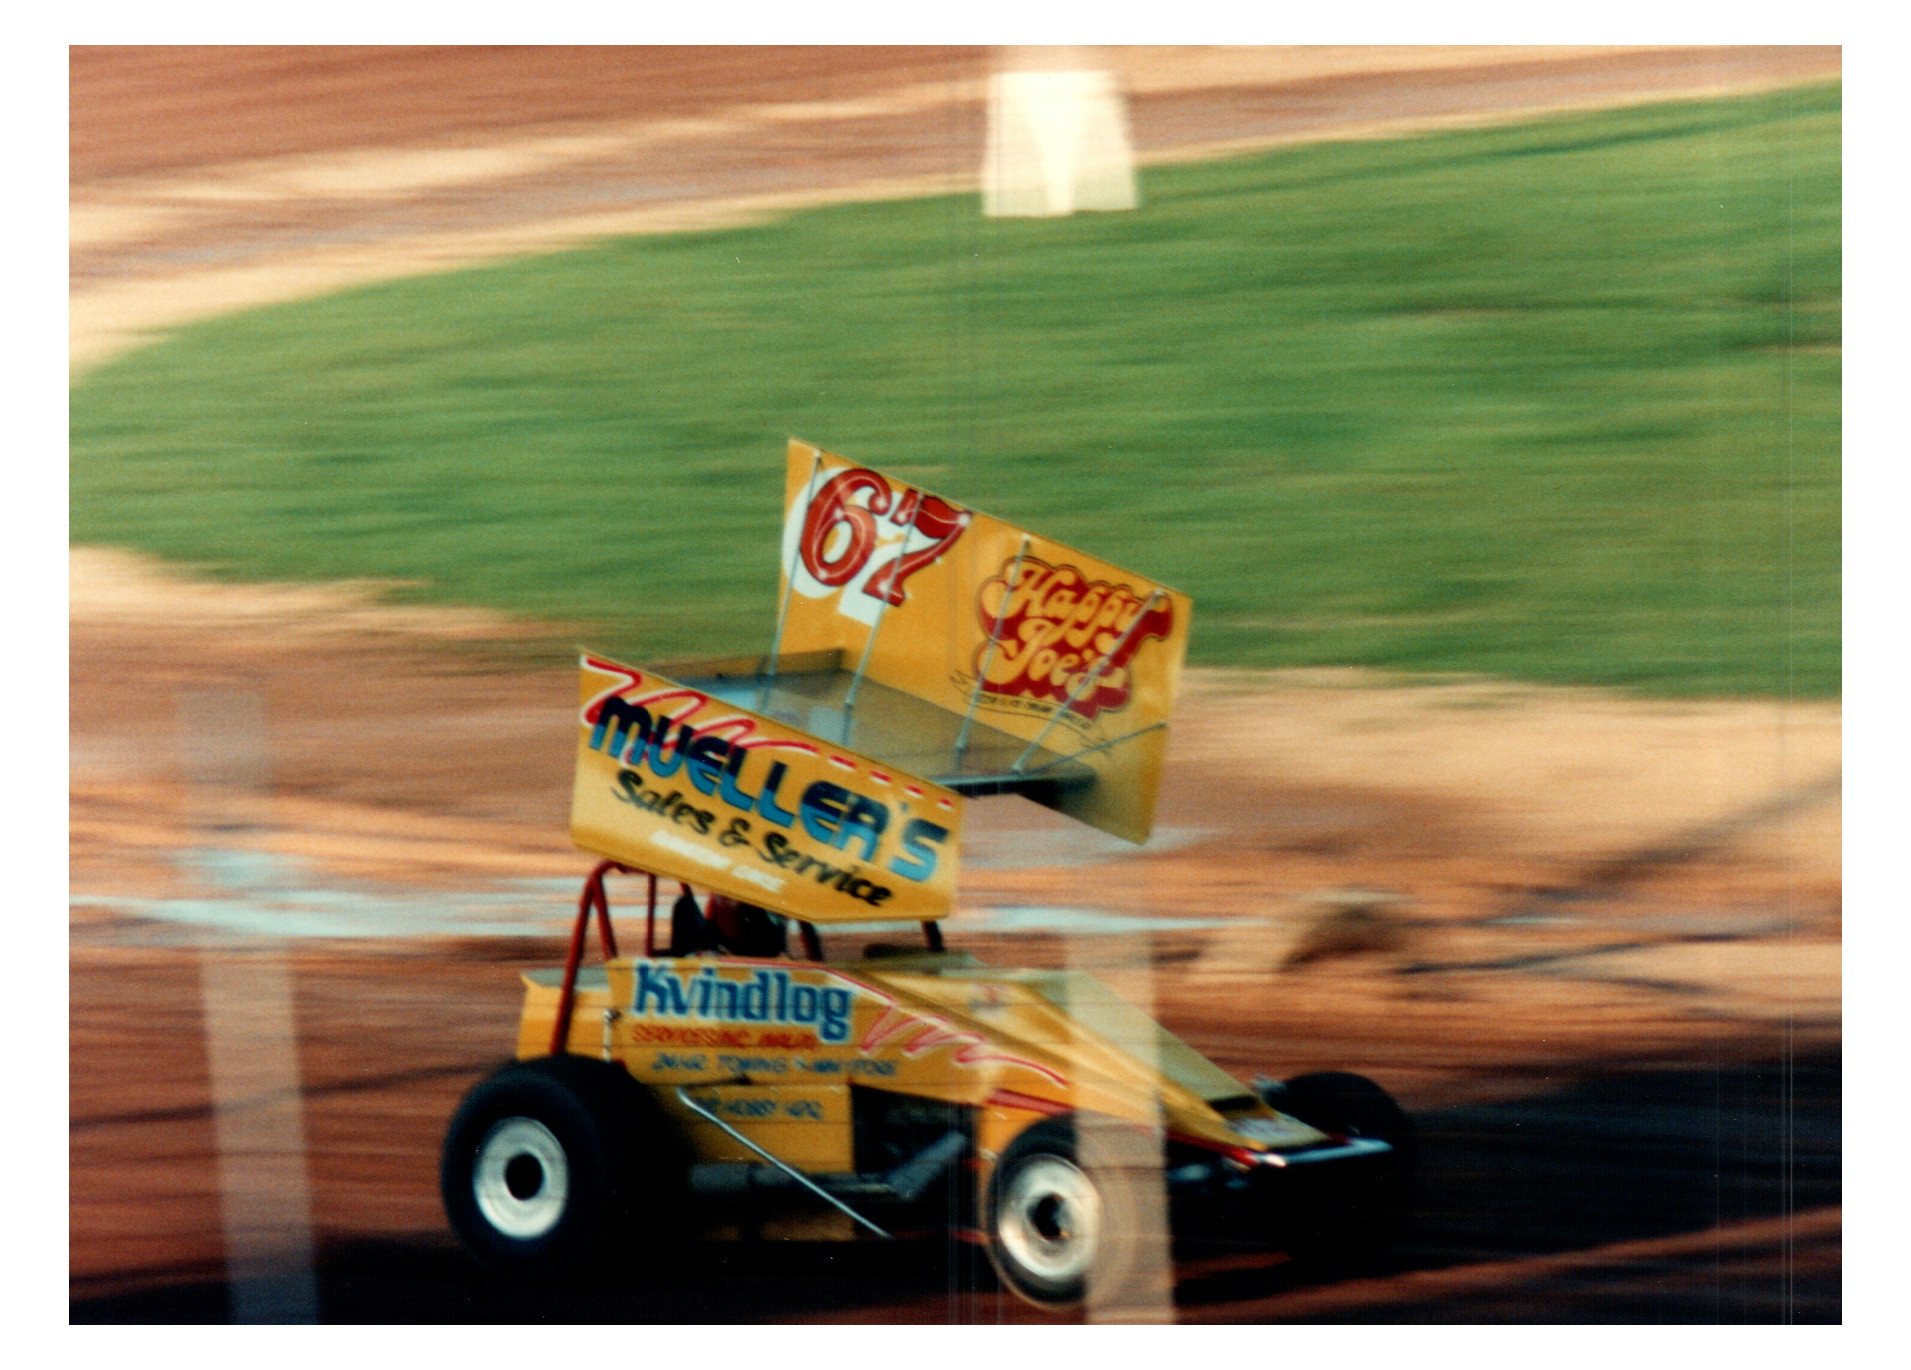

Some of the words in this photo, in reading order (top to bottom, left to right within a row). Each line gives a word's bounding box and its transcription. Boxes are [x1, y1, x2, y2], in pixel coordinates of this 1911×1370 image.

[800, 467, 974, 608] 67
[980, 556, 1171, 655] Happy
[974, 616, 1128, 703] Joe's
[612, 768, 716, 836] Sales
[719, 817, 752, 848] &
[757, 831, 894, 907] Service
[632, 962, 853, 1043] Kvindlog
